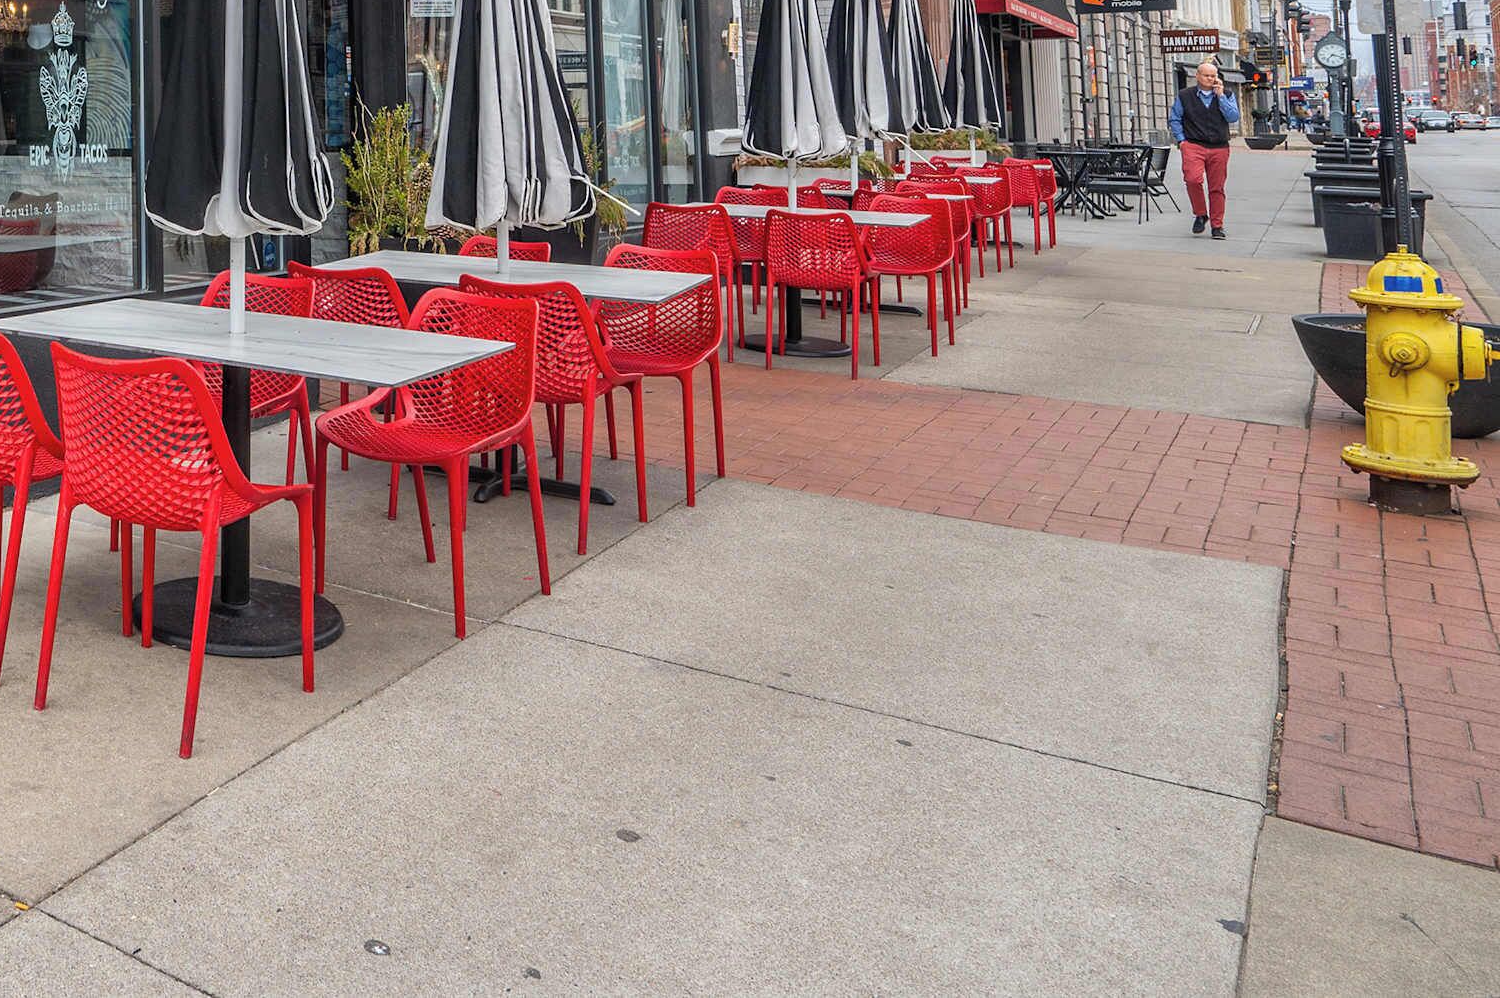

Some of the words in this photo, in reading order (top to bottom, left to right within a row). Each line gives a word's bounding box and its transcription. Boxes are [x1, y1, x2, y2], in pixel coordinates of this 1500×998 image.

[1162, 35, 1217, 47] HANNAFORD
[29, 145, 51, 167] EPIC
[80, 143, 108, 164] TACOS
[44, 202, 53, 216] &
[56, 201, 101, 213] Bourbon
